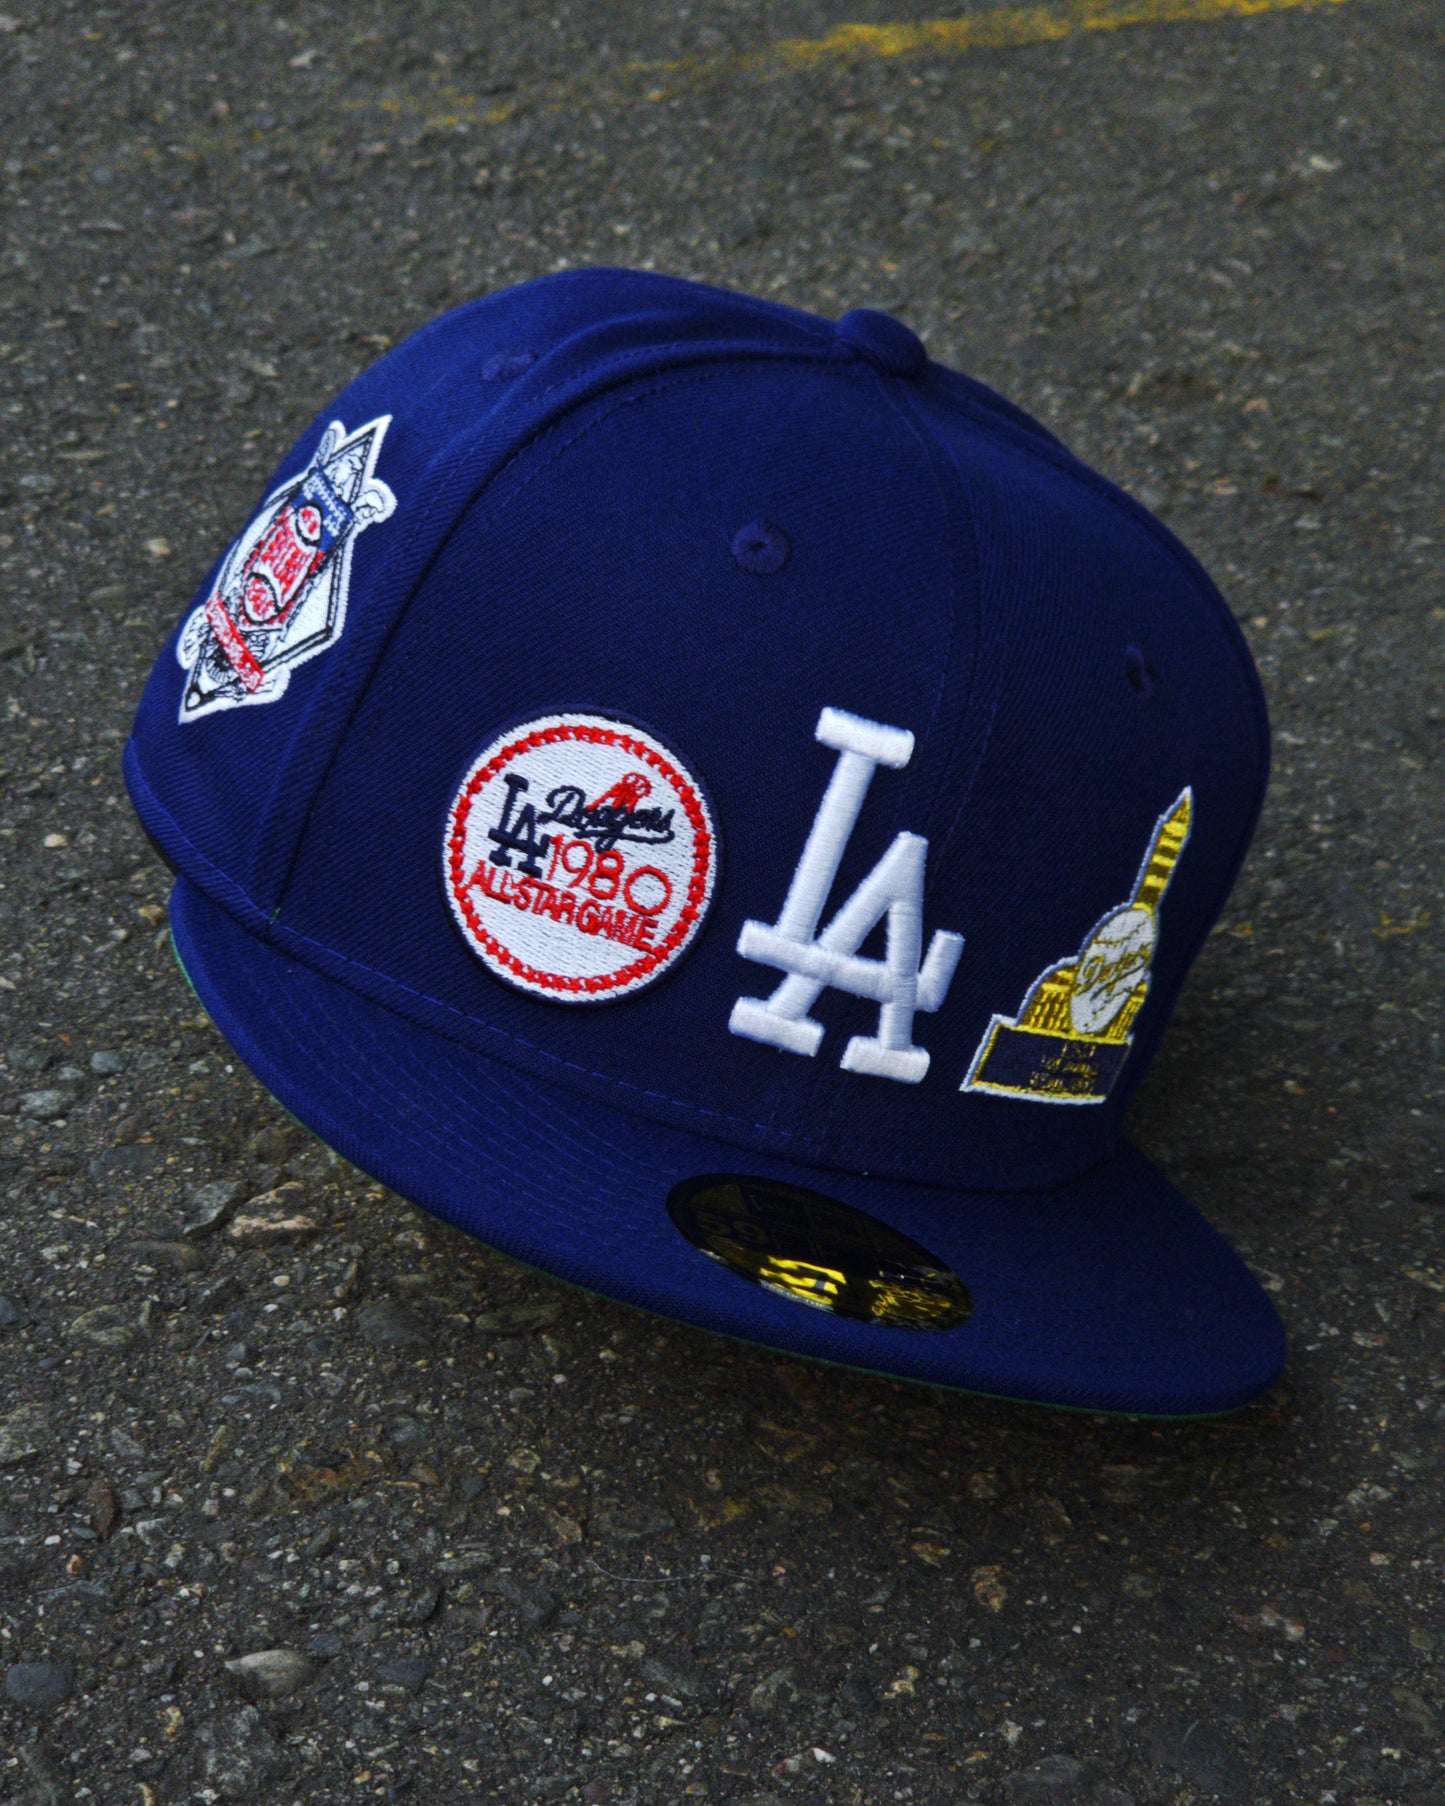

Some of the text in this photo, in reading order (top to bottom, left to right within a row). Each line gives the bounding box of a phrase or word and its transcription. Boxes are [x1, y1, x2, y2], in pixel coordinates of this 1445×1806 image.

[487, 772, 552, 879] LA
[537, 785, 676, 855] Dodgers
[546, 833, 673, 917] 1980
[728, 706, 966, 1085] LA
[576, 898, 660, 954] GAME
